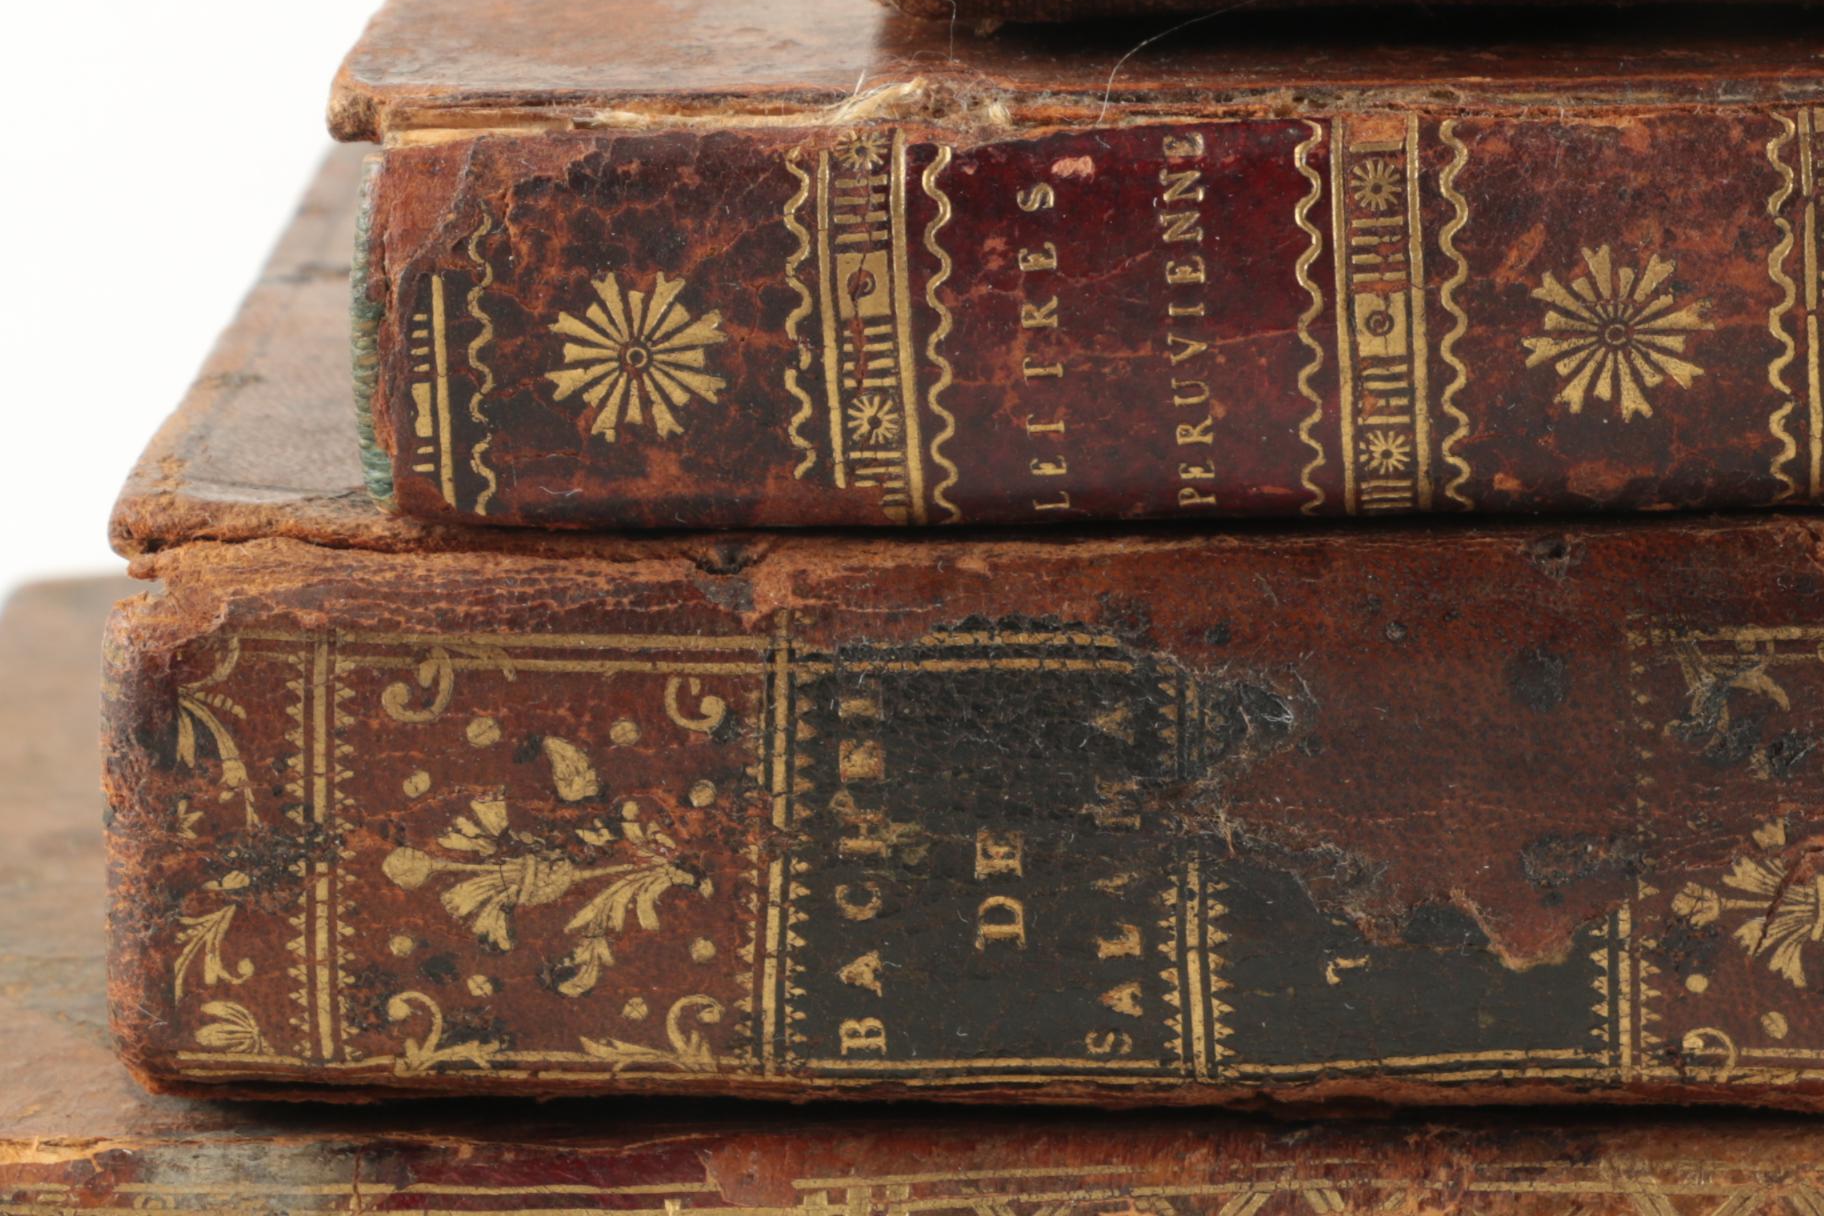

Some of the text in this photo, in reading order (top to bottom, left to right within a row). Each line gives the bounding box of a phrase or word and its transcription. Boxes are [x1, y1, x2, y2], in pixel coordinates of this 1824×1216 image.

[1017, 182, 1070, 511] LETTRES
[1160, 133, 1217, 506] PERUVIENNE
[975, 829, 1026, 951] DE
